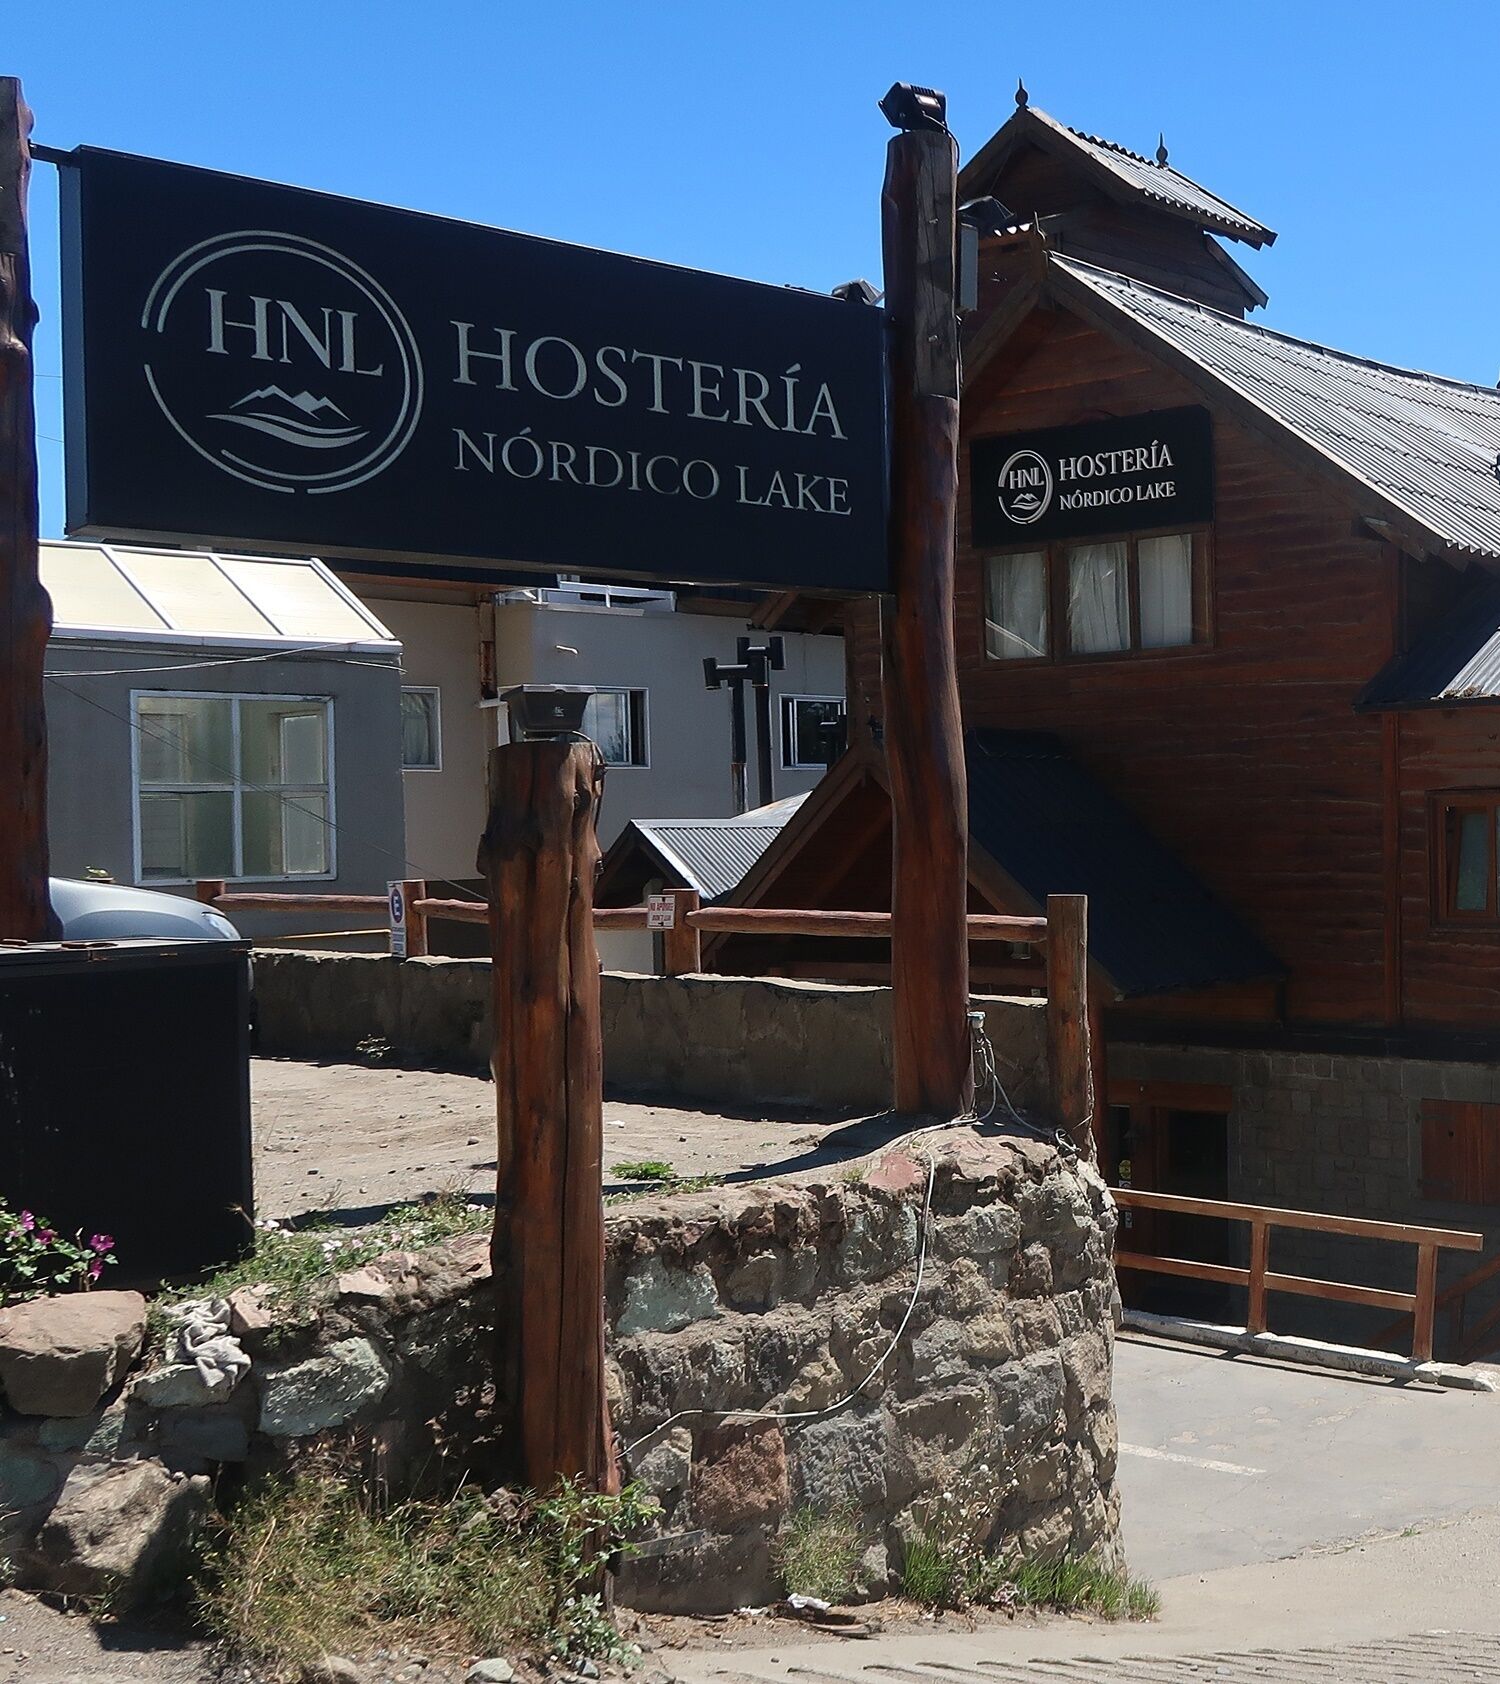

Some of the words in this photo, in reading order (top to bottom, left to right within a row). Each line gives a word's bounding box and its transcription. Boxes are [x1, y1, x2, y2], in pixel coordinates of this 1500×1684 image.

[205, 287, 383, 377] HNL
[450, 320, 848, 441] HOSTERÍA
[452, 426, 720, 500] NÓRDICO
[736, 464, 853, 516] LAKE
[1009, 467, 1045, 490] HNL
[1058, 439, 1175, 482] HOSTERÍA
[1059, 488, 1134, 511] NÓRDICO
[1136, 481, 1177, 501] LAKE
